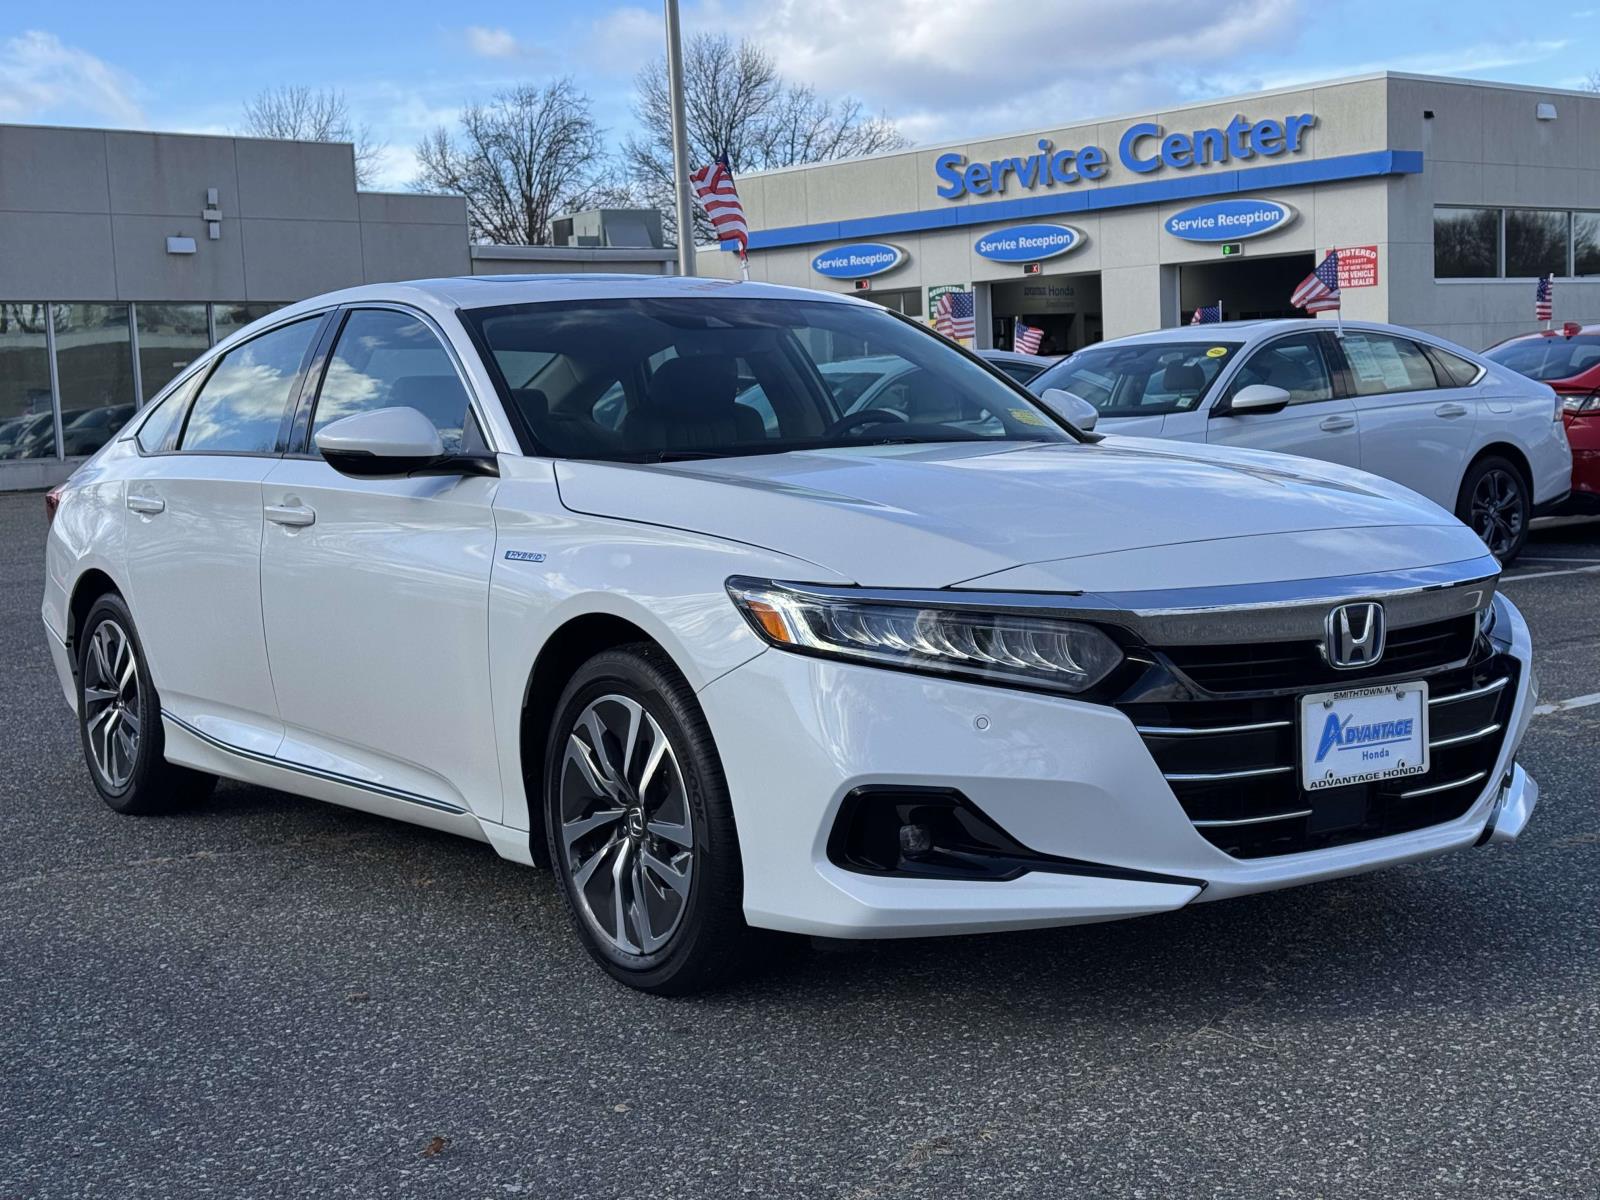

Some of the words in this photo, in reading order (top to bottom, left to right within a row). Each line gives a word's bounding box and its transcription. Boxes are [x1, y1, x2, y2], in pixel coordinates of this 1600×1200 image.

[935, 138, 1108, 200] Service
[1118, 113, 1318, 174] Center
[1171, 215, 1214, 231] Service
[1217, 209, 1280, 229] Reception
[980, 236, 1017, 253] Service
[1018, 231, 1071, 250] Reception
[816, 256, 848, 270] Service
[849, 251, 895, 268] Reception
[1337, 249, 1377, 259] GISTERED
[1350, 269, 1375, 278] VEHICLE
[1048, 283, 1074, 297] Honda
[1337, 279, 1350, 287] TAIL
[1351, 278, 1375, 286] DEALER
[510, 551, 542, 561] HYBRID
[1314, 711, 1414, 764] ADVANTAGE
[1362, 748, 1390, 761] Honda
[1310, 771, 1380, 789] ADVANTAGE
[1383, 765, 1424, 779] HONDA
